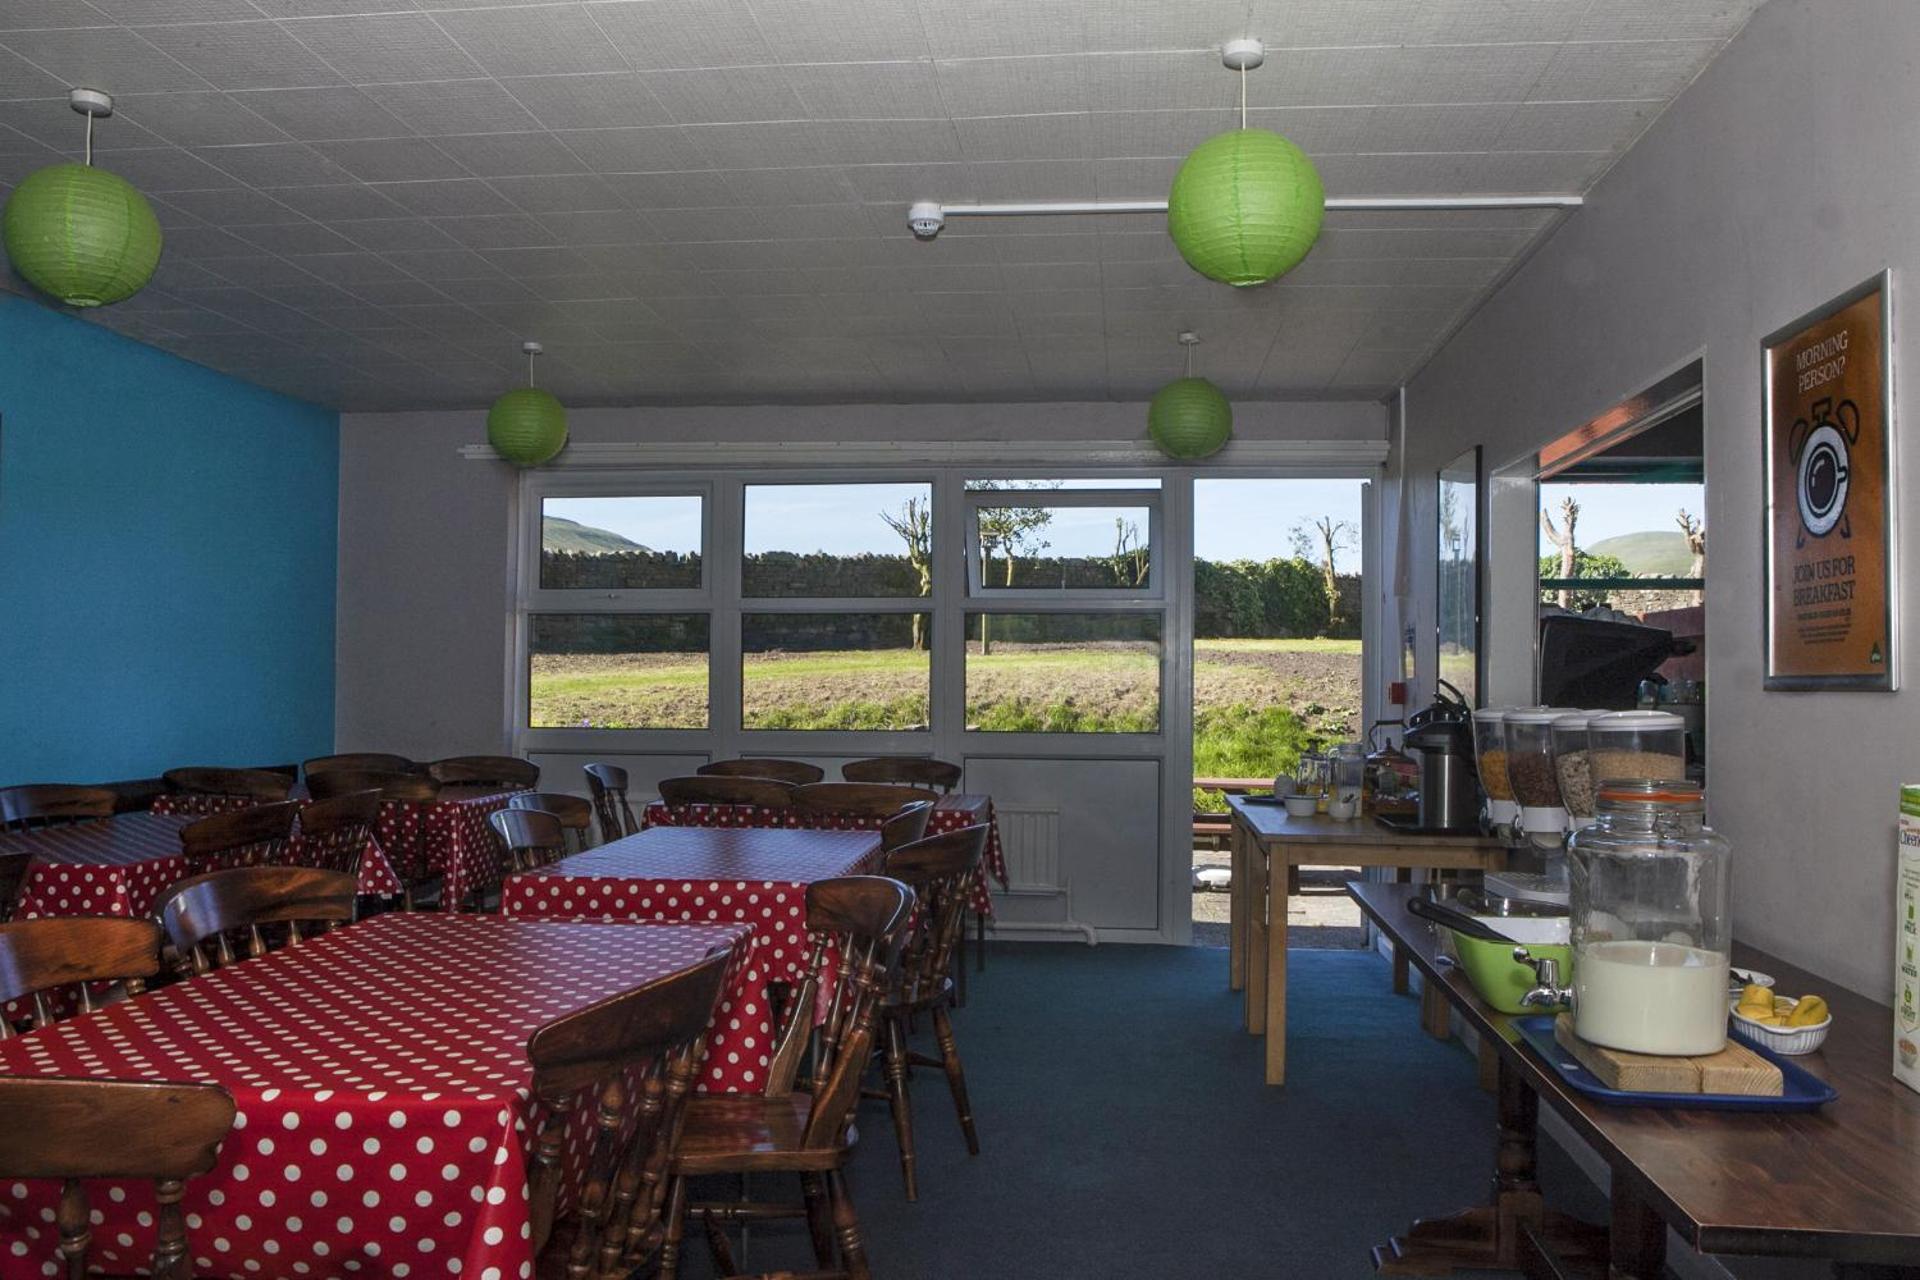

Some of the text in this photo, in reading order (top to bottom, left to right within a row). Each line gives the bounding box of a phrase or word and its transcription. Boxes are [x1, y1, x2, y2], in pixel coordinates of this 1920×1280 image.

[1796, 329, 1848, 372] MORNING
[1798, 355, 1846, 394] PERSON?
[1794, 555, 1856, 584] JOIN US FOR
[1793, 580, 1856, 606] BREAKFAST
